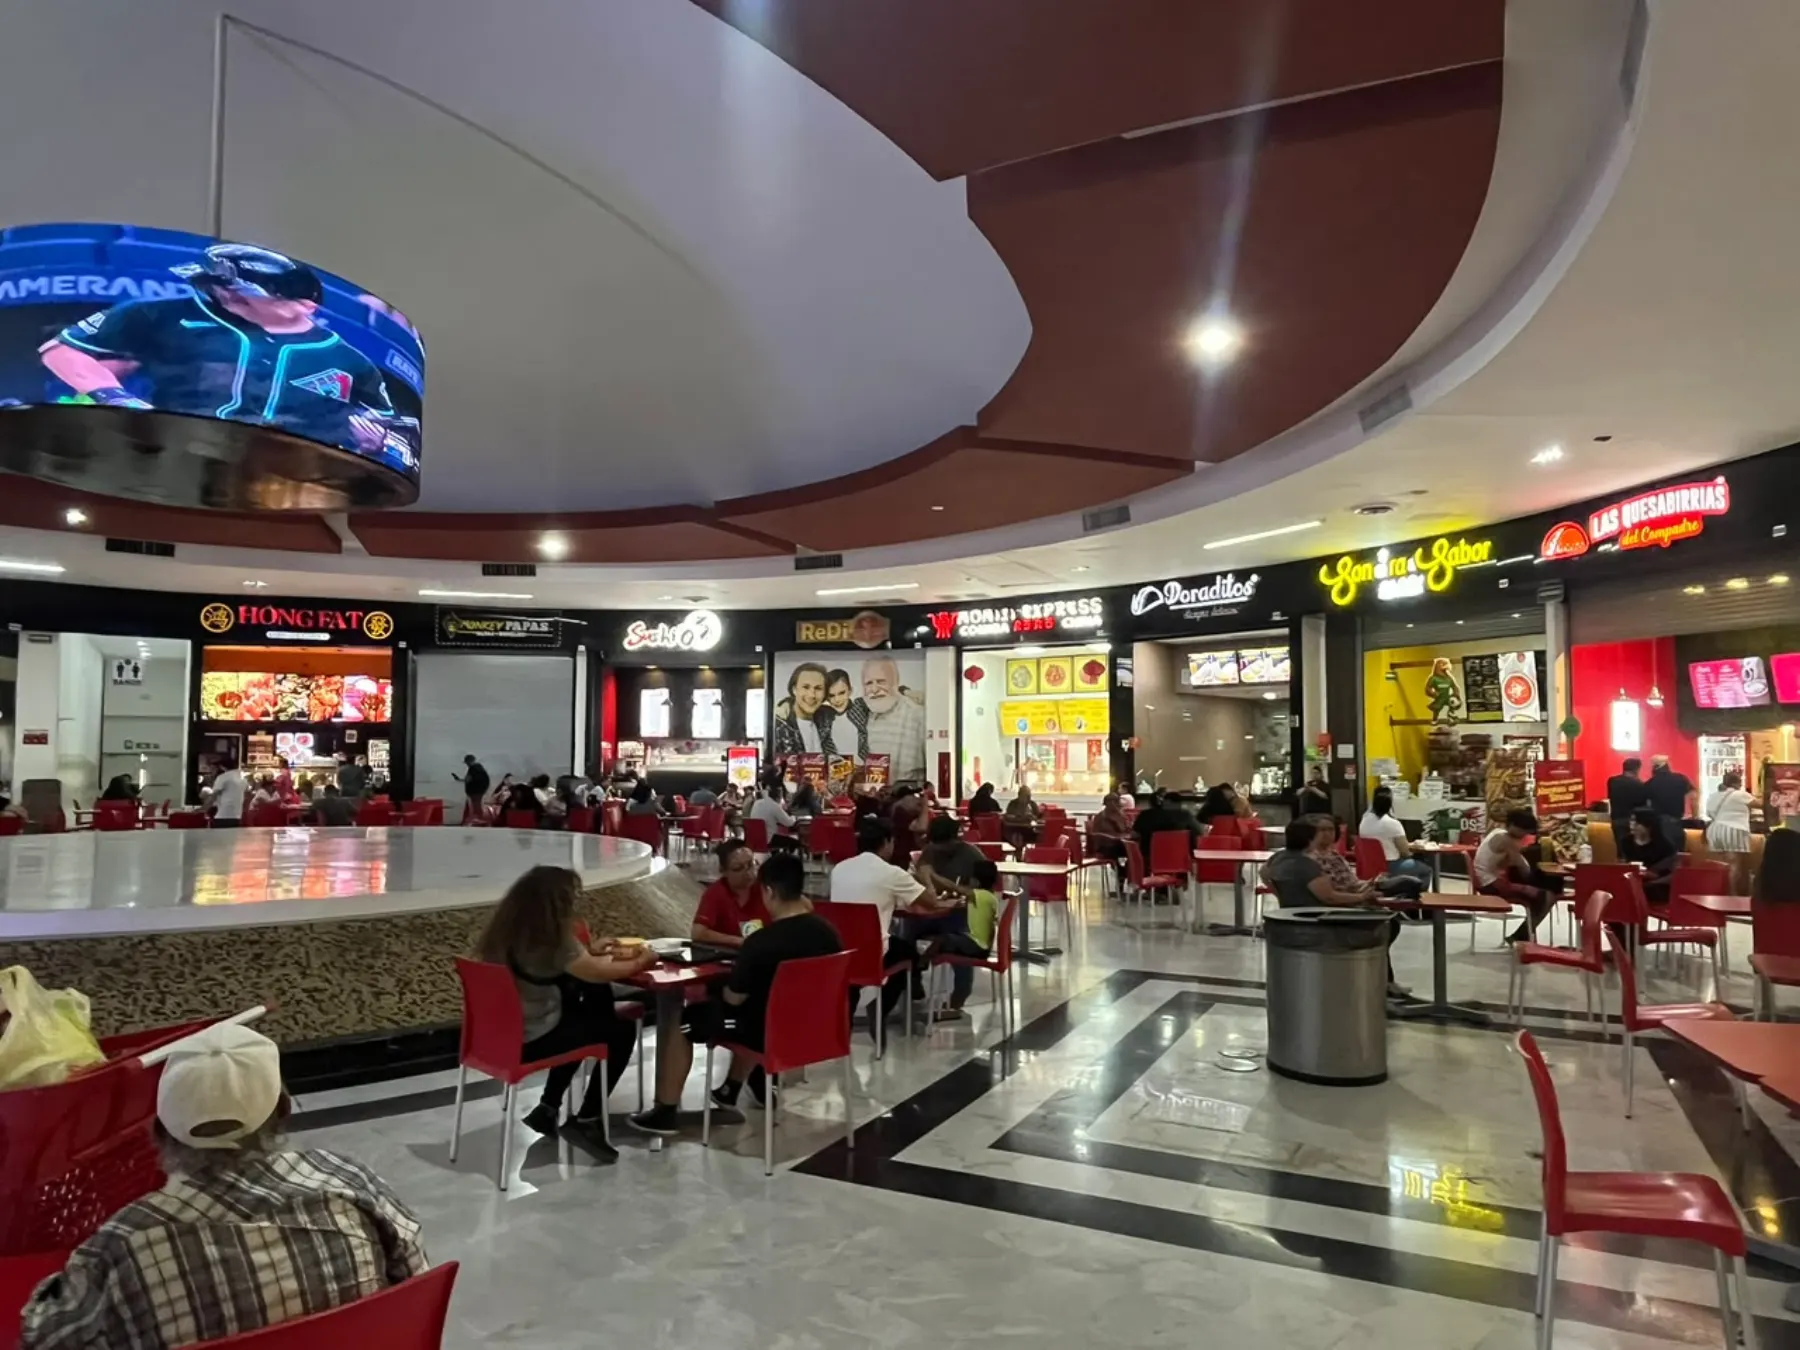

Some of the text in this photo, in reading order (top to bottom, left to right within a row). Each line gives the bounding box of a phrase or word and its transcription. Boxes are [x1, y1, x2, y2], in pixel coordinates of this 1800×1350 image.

[1593, 485, 1726, 538] LAS QUESABIRRIAS
[1415, 538, 1492, 592] Sabor
[1163, 573, 1253, 606] Doraditos
[238, 605, 363, 630] HONG FAT
